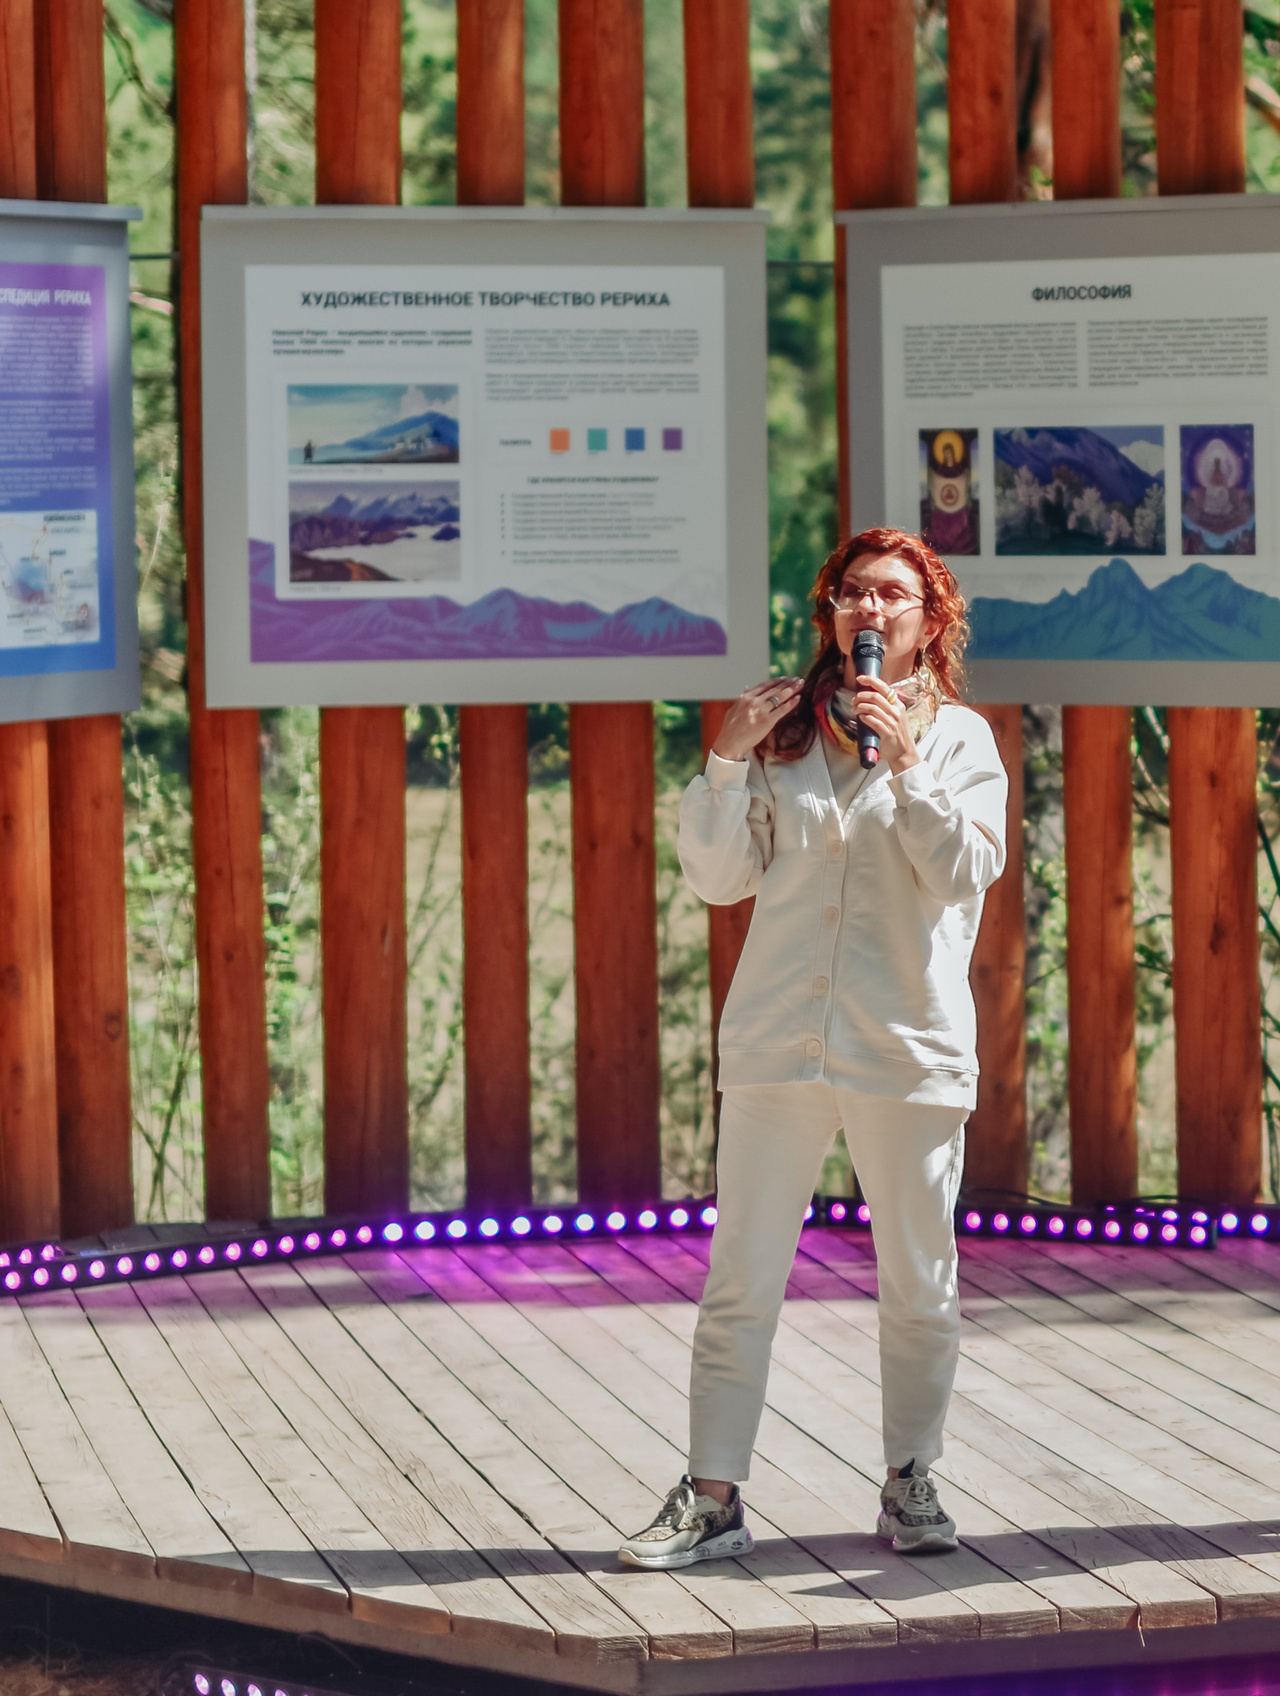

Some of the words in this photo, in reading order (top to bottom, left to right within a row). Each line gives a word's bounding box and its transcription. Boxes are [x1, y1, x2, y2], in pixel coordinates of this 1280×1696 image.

[54, 289, 92, 306] РЕРИХА
[301, 291, 474, 309] ХУДОЖЕСТВЕННОЕ
[478, 291, 595, 307] ТВОРЧЕСТВО
[600, 291, 671, 306] РЕРИХА
[1031, 284, 1132, 301] ФИЛОСОФИЯ
